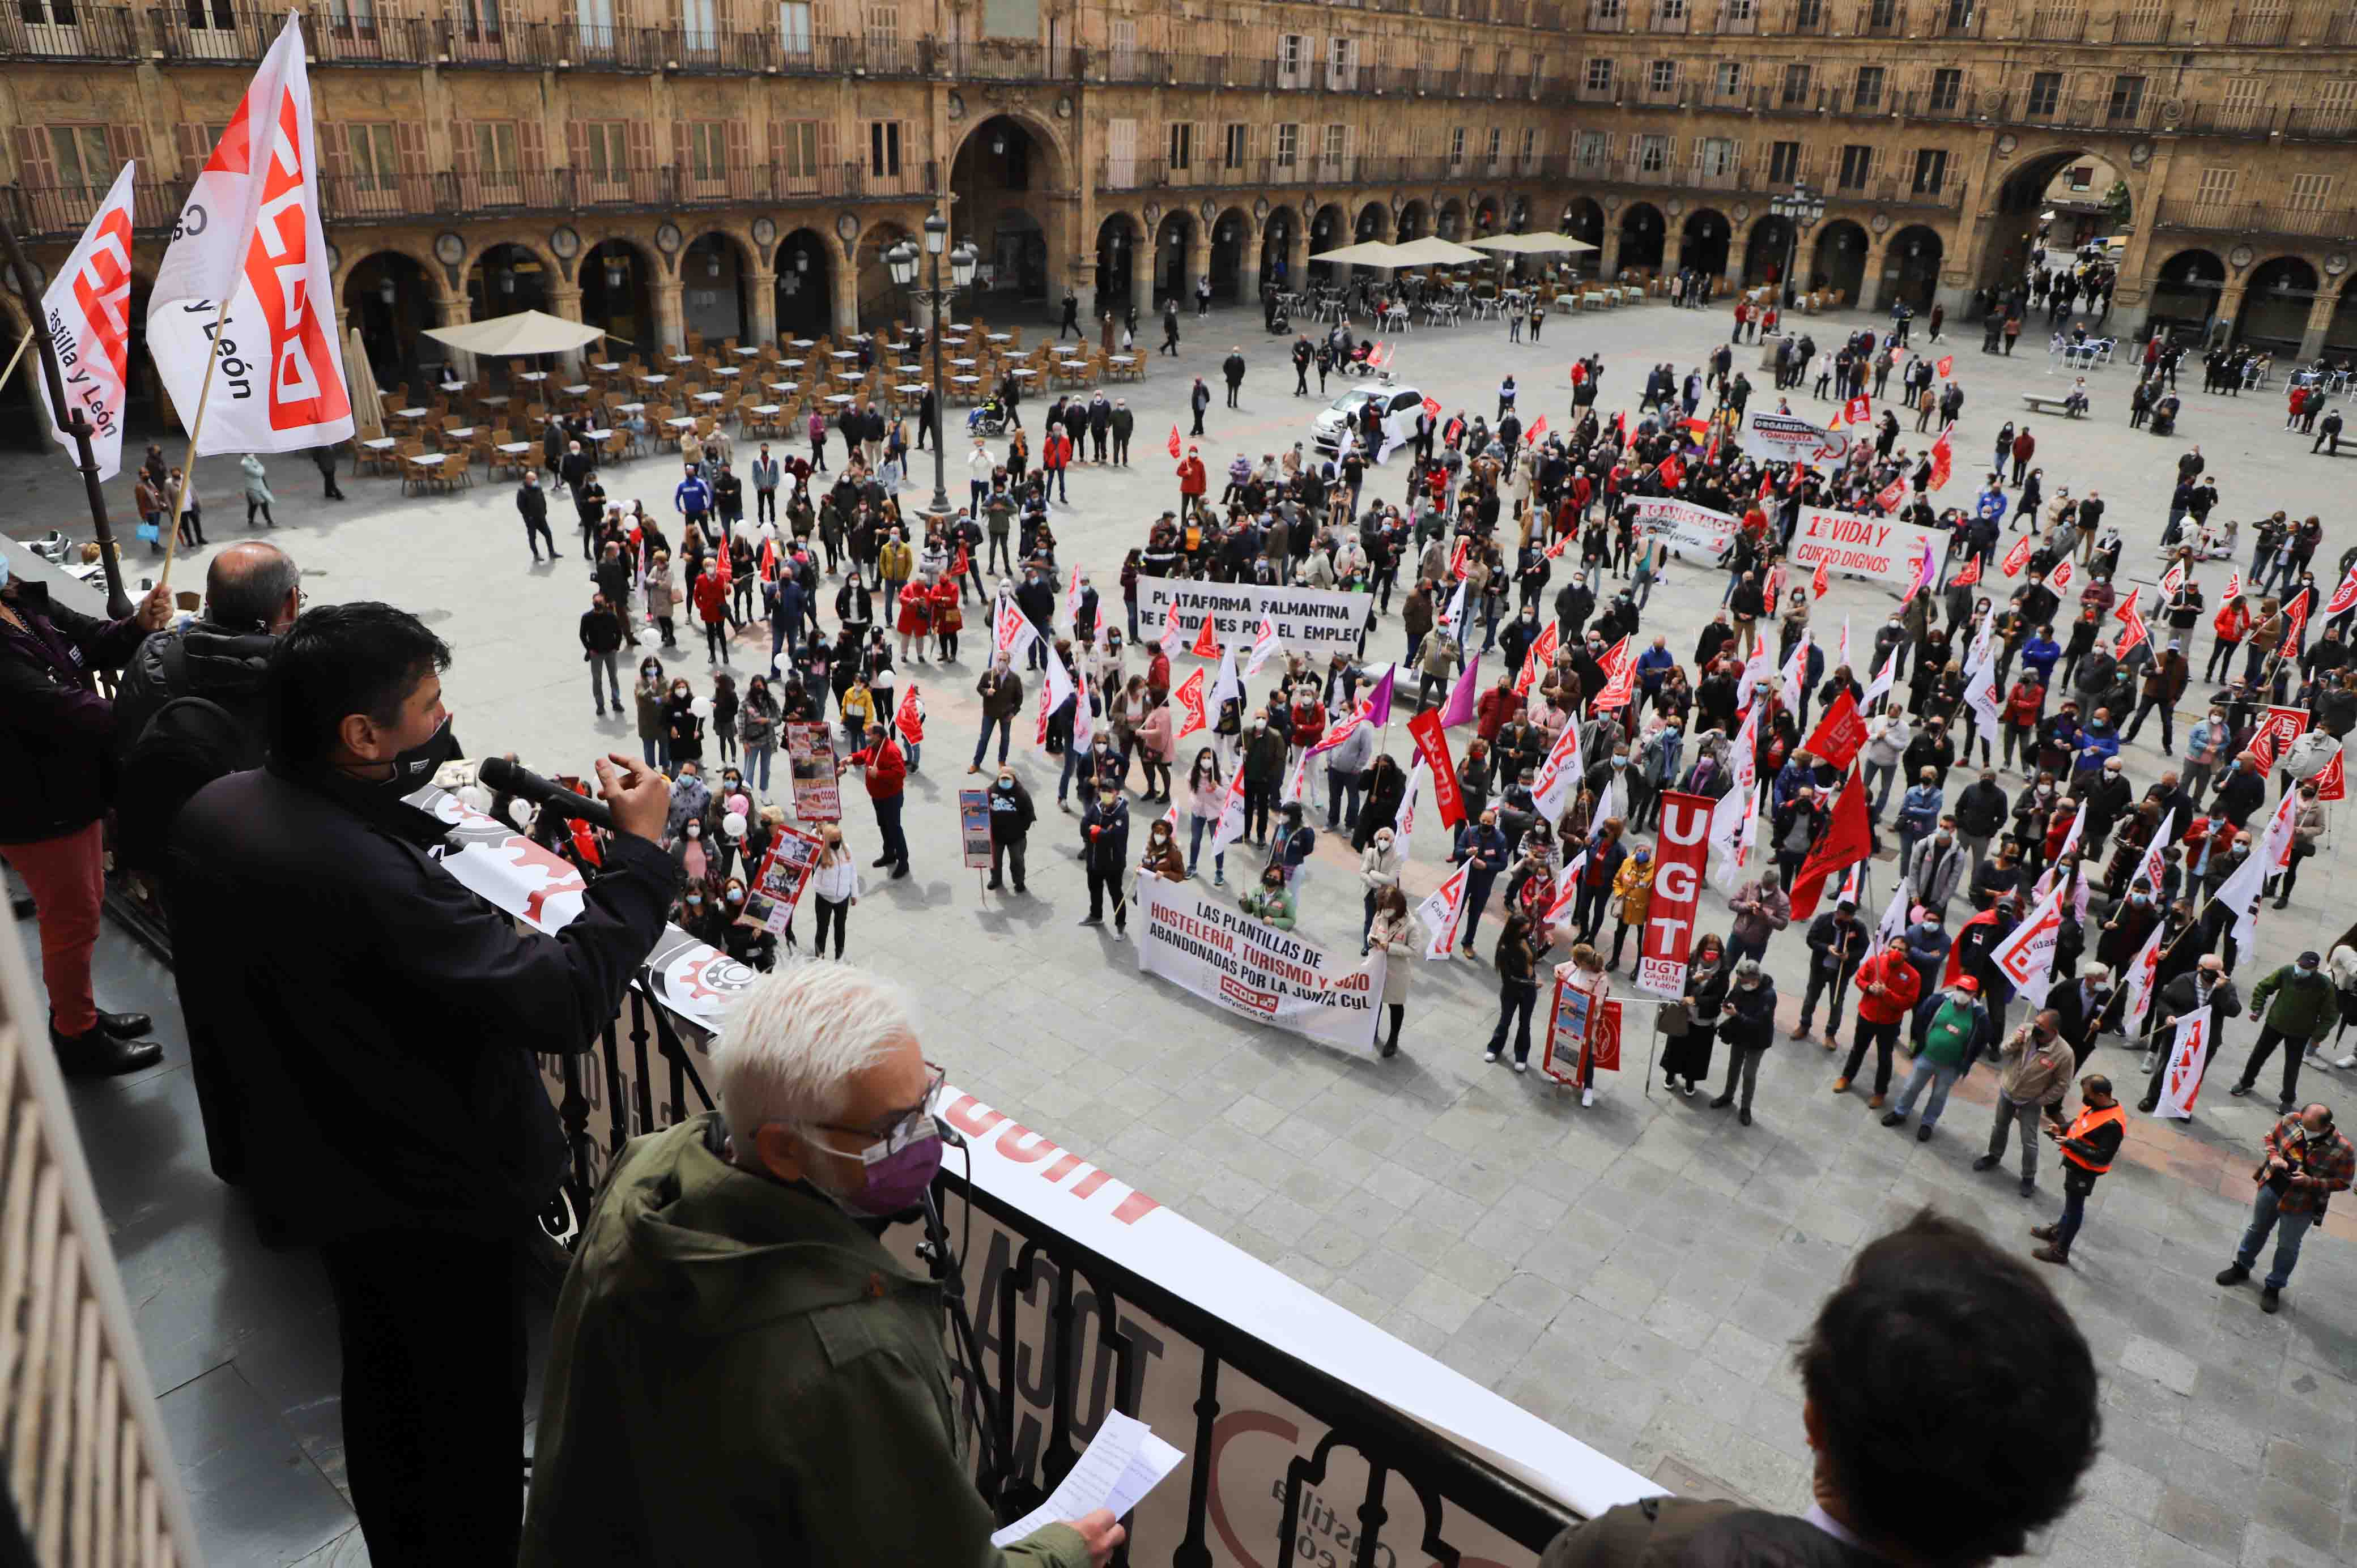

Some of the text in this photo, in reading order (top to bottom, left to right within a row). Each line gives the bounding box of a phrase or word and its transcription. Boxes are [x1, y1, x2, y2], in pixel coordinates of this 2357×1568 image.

[202, 317, 252, 399] León
[49, 307, 117, 438] astilla y León
[1831, 519, 1870, 545] VIDA
[1875, 526, 1891, 547] Y
[1841, 551, 1890, 573] DIGNOS
[1260, 600, 1350, 620] SALMANTINA
[1278, 624, 1295, 638] EL
[1654, 803, 1708, 955] UGT
[1151, 901, 1236, 958] HOSTELERÍA,
[1242, 943, 1314, 986] TURISMO
[1318, 975, 1329, 990] Y
[1197, 901, 1324, 970] LAS PLANTILLAS DE
[1150, 923, 1371, 1011] ABANDONADAS POR LA JUNTA CyL
[1644, 958, 1683, 976] UGT
[1644, 971, 1680, 984] Castilla
[1223, 979, 1258, 1005] CCOO
